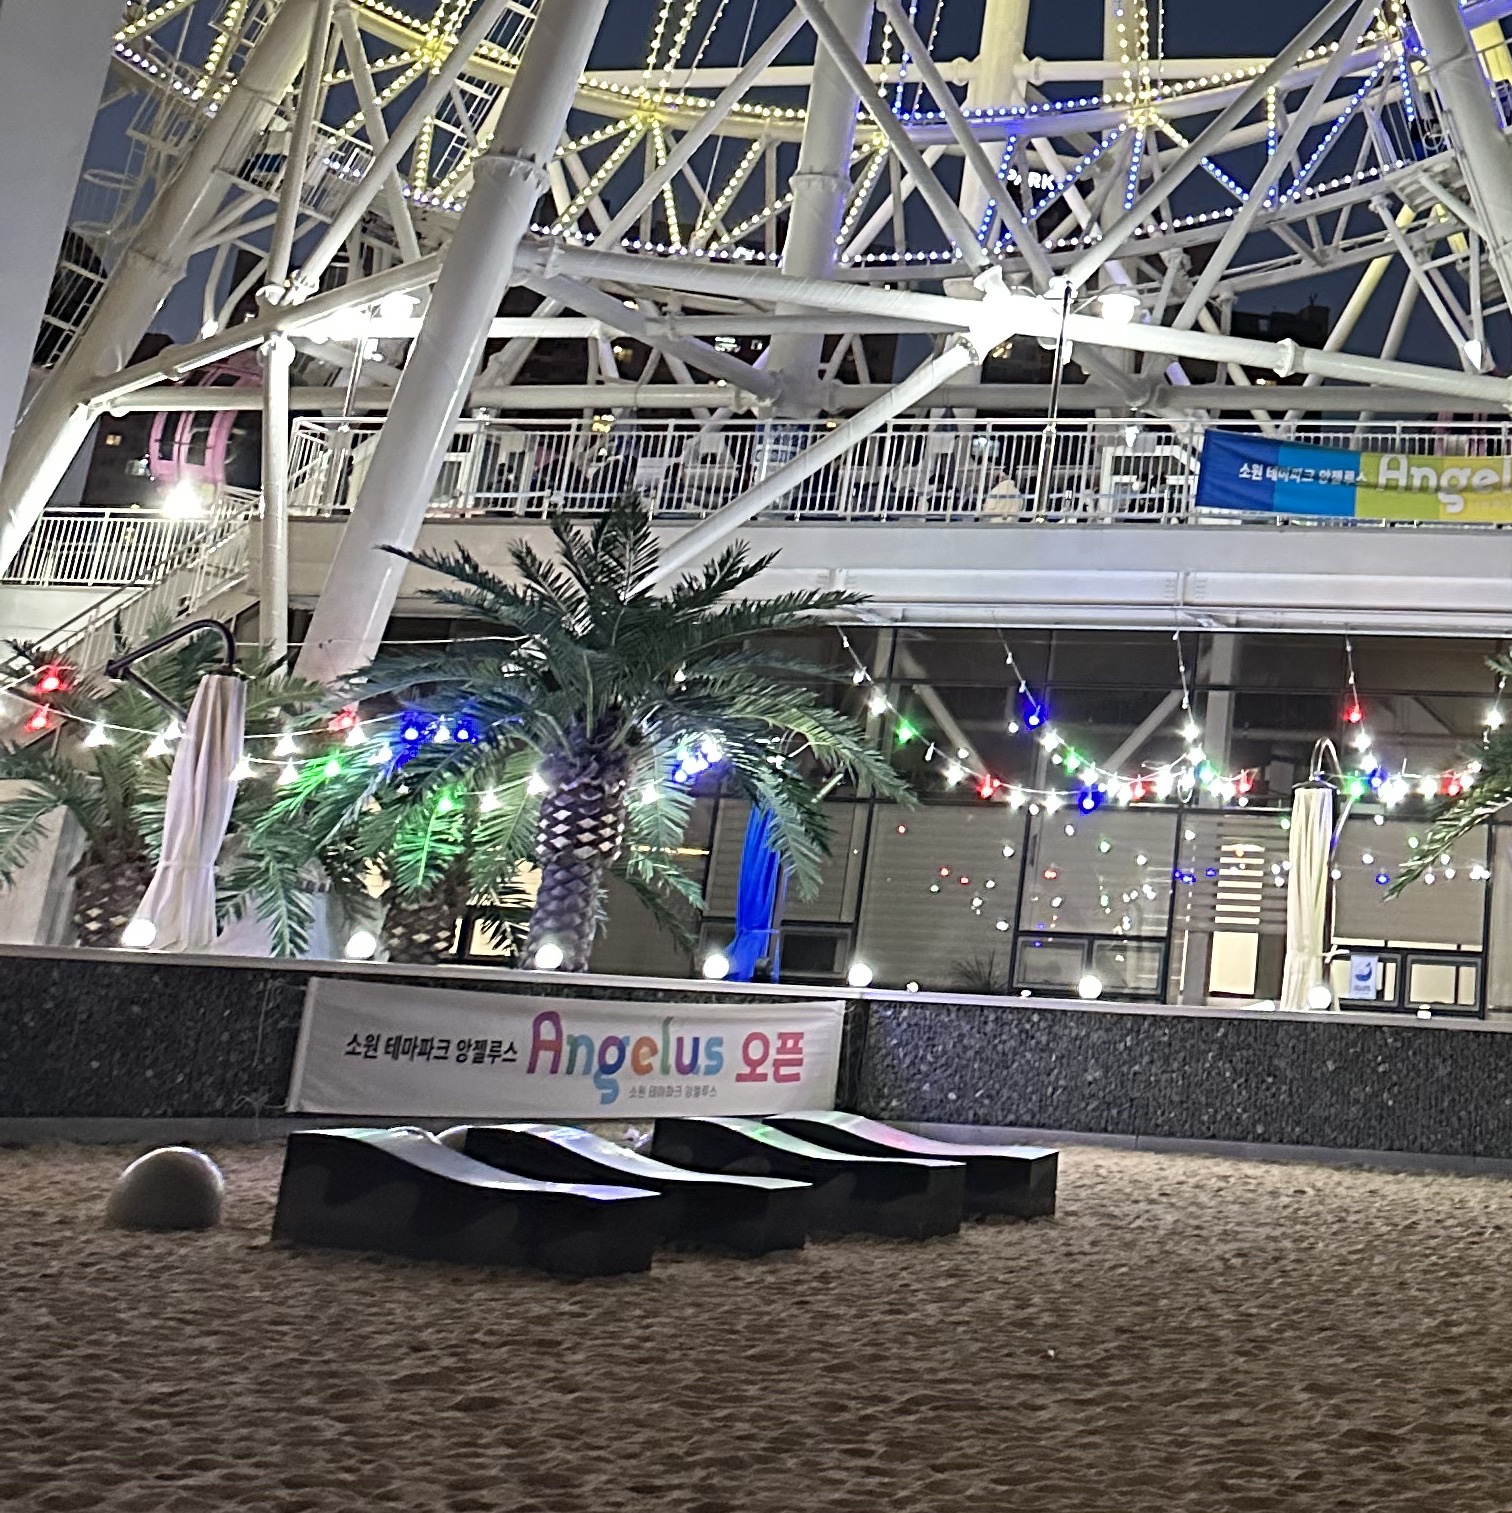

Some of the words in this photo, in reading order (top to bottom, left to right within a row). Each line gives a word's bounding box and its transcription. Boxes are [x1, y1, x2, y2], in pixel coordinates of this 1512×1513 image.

[1239, 463, 1263, 481] 소원
[344, 1034, 381, 1059] 소원
[384, 1035, 451, 1062] 테마파크
[455, 1038, 518, 1064] 앙젤루스
[526, 1011, 725, 1105] Angelus
[735, 1031, 805, 1083] 오픈
